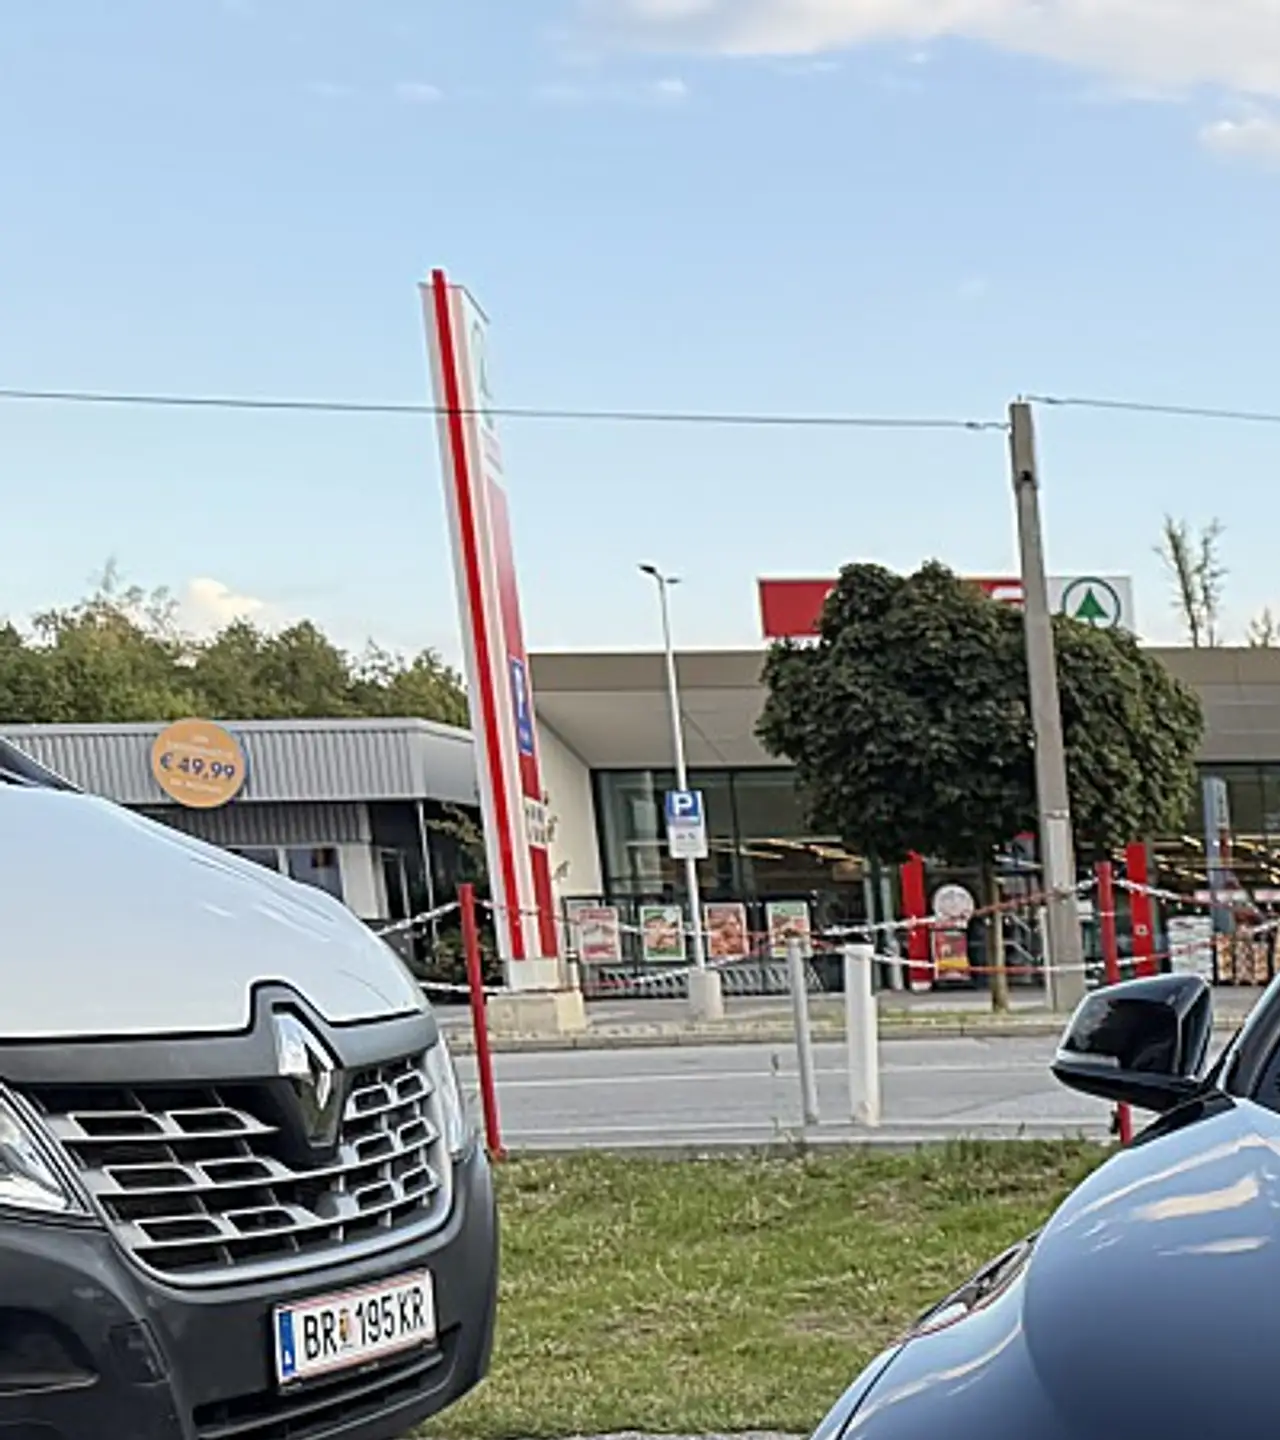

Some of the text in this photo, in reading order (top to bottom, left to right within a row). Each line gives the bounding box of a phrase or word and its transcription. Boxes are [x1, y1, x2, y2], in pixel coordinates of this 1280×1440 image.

[672, 793, 694, 816] P
[304, 1287, 425, 1360] BR 195 KR
